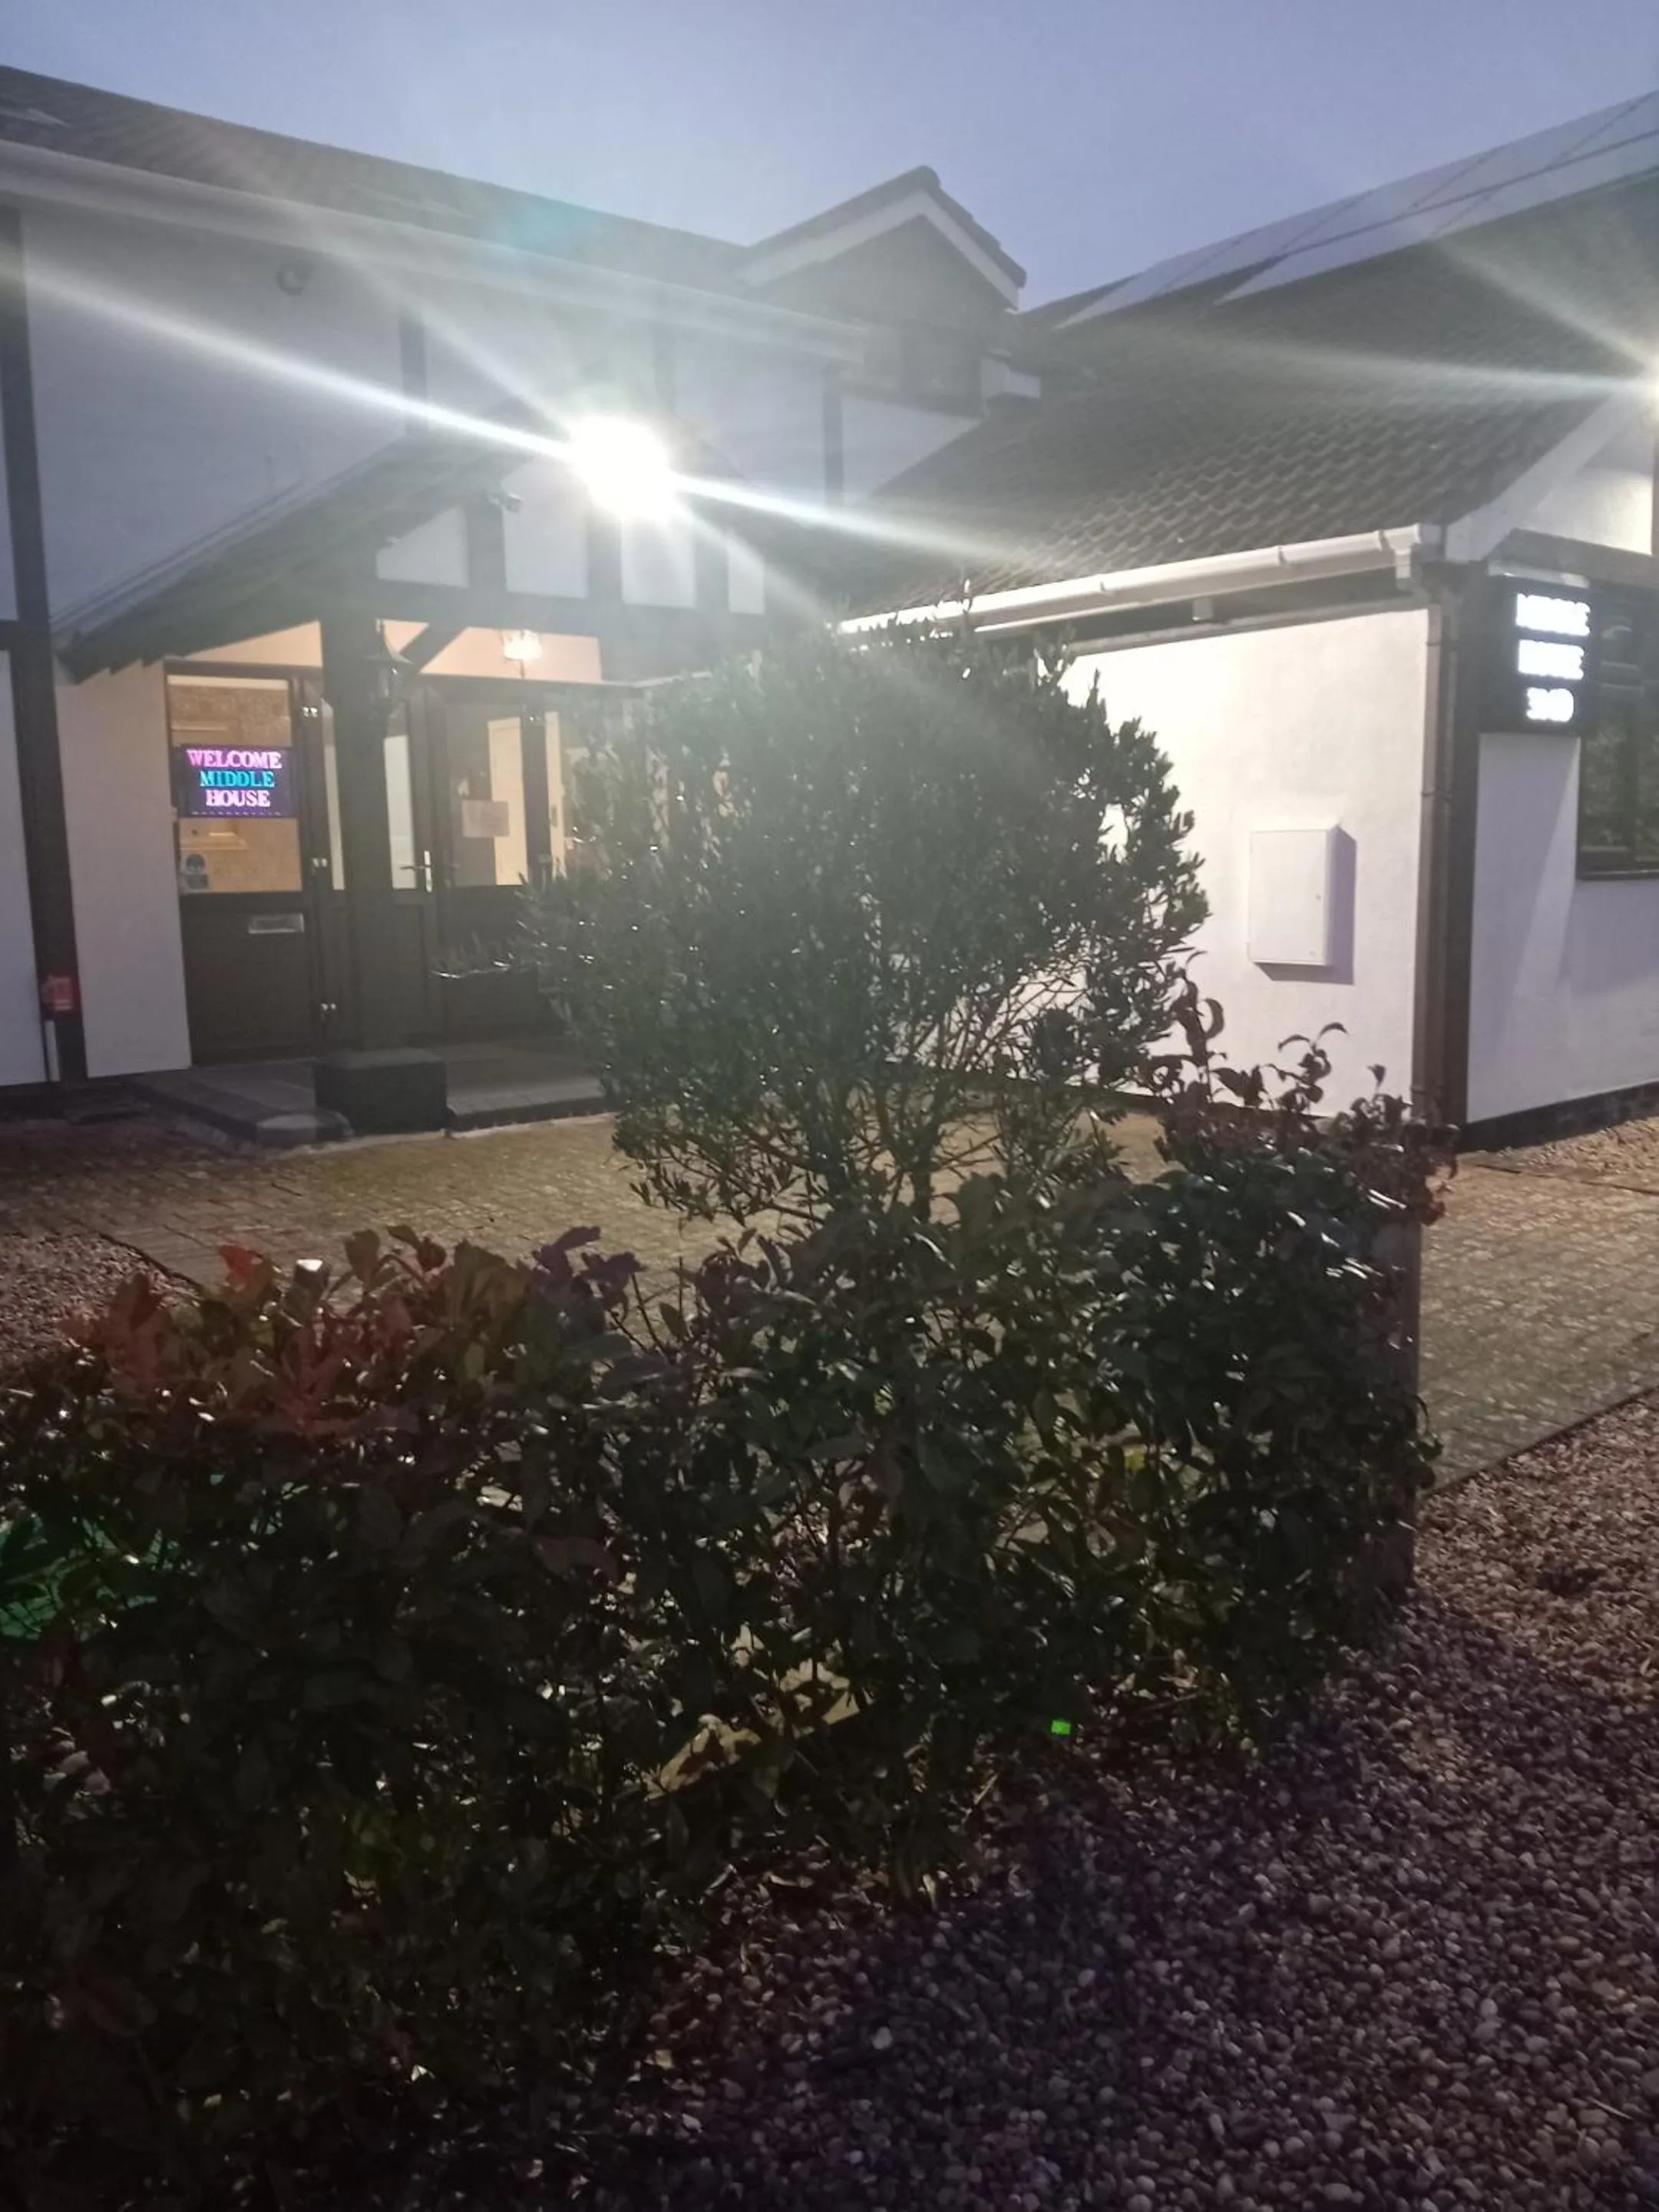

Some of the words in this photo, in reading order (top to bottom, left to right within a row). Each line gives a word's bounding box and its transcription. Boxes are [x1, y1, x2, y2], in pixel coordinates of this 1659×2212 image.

[187, 749, 282, 769] WELCOME
[200, 770, 275, 788] MIDDLE
[206, 790, 270, 806] HOUSE
